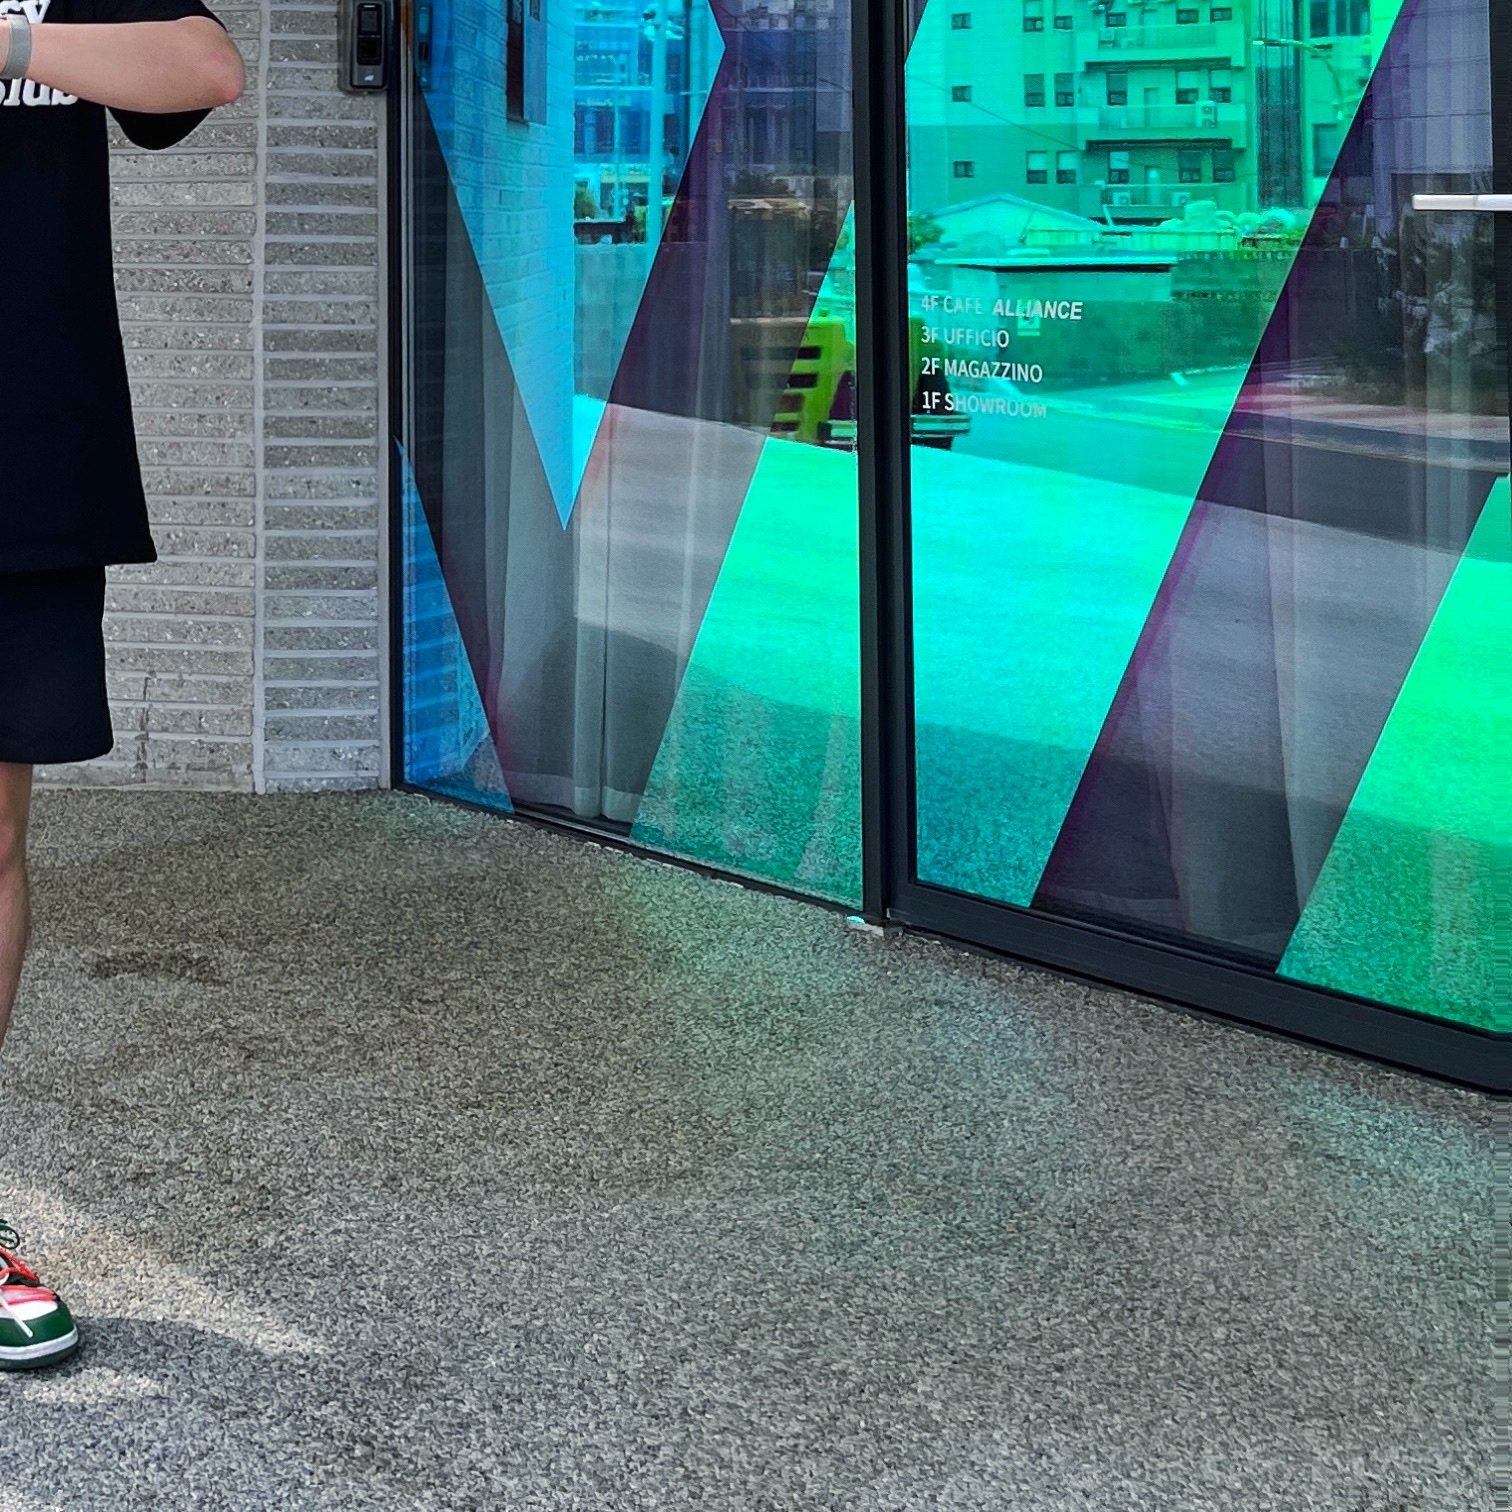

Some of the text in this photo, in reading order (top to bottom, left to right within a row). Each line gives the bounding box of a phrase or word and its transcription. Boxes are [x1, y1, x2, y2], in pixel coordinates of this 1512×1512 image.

[921, 295, 1084, 320] 4F CAFE ALLIANCE
[920, 325, 1010, 348] 3F UFFICIO
[921, 357, 1044, 383] 2F MAGAZZINO
[922, 390, 1048, 418] 1F SHOWROOM
